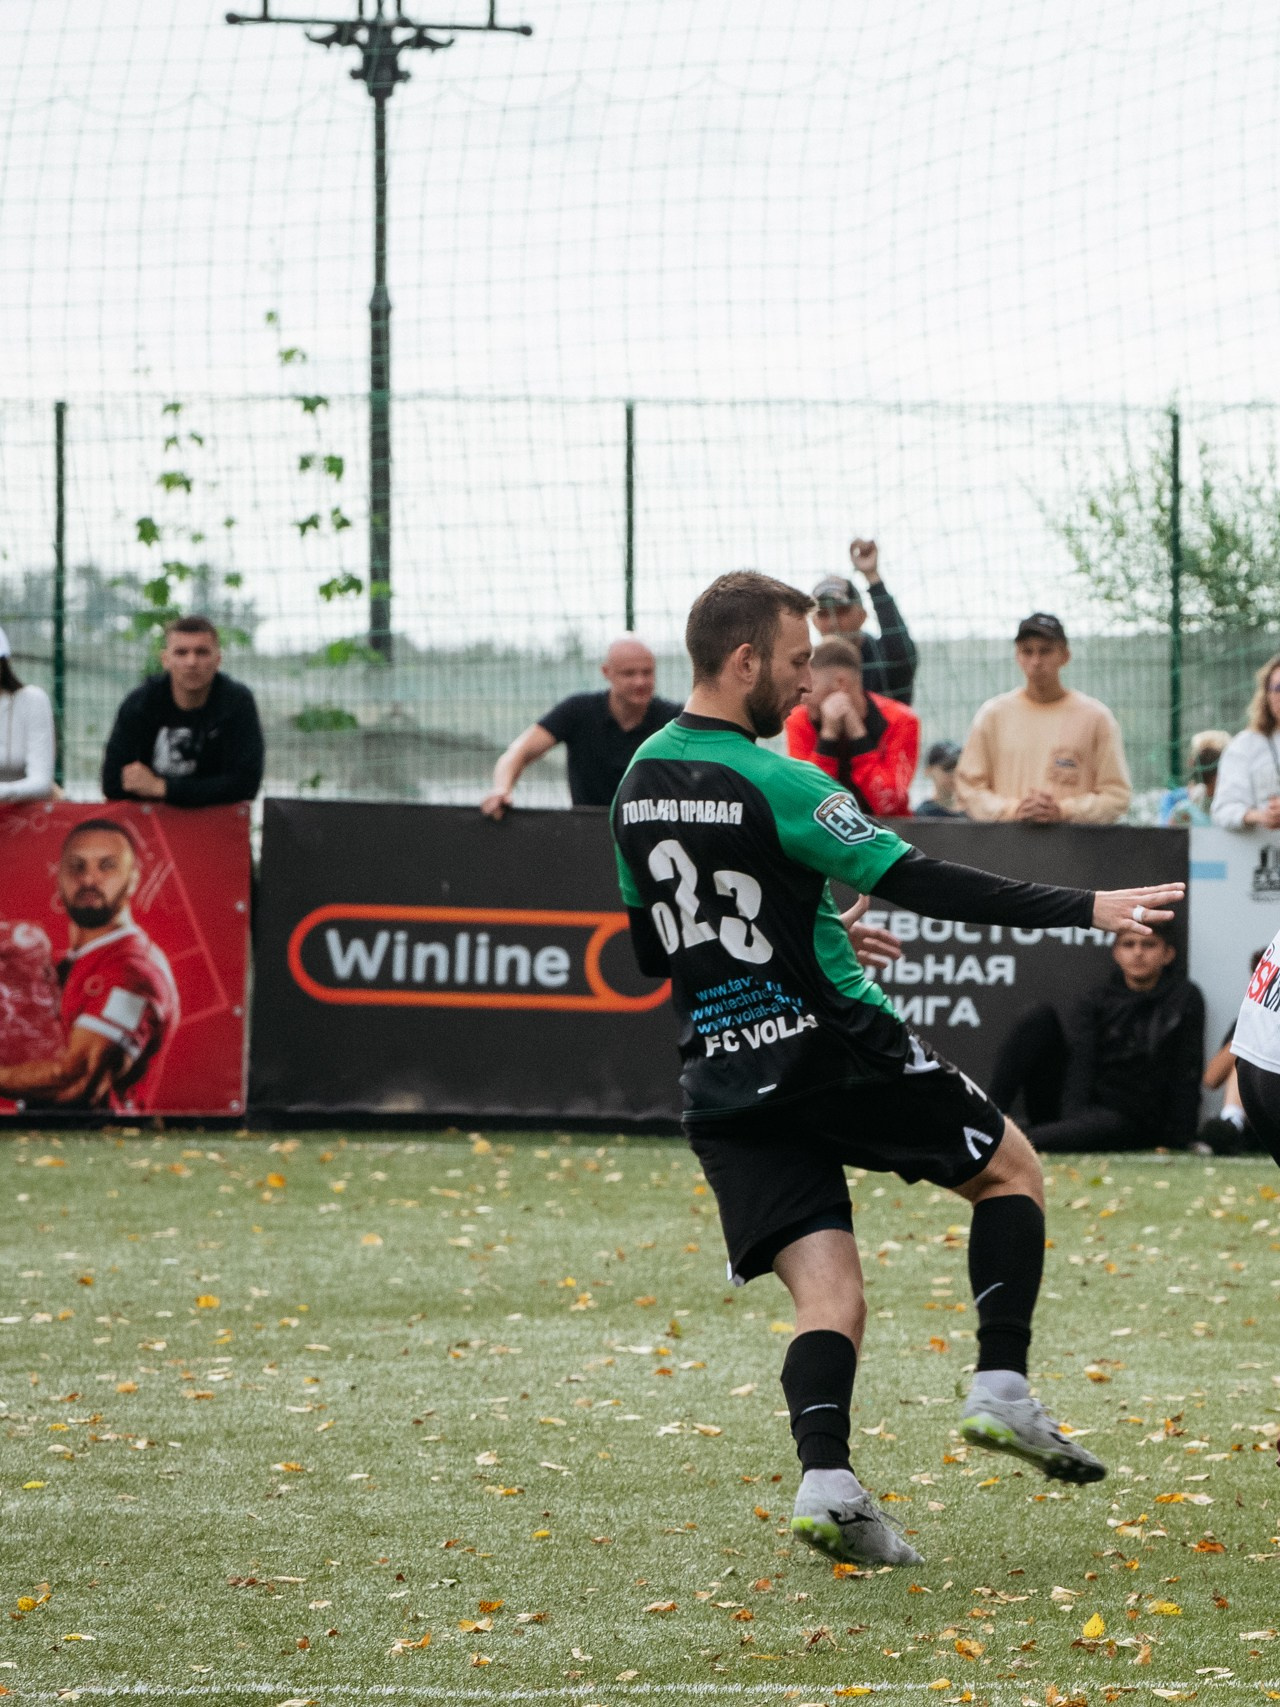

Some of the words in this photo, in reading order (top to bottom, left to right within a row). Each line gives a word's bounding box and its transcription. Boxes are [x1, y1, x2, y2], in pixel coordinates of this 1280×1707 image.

[622, 799, 679, 825] ТОЛЬКО
[680, 800, 744, 825] ПРАВАЯ
[325, 928, 571, 988] Winline
[705, 1029, 740, 1058] FC
